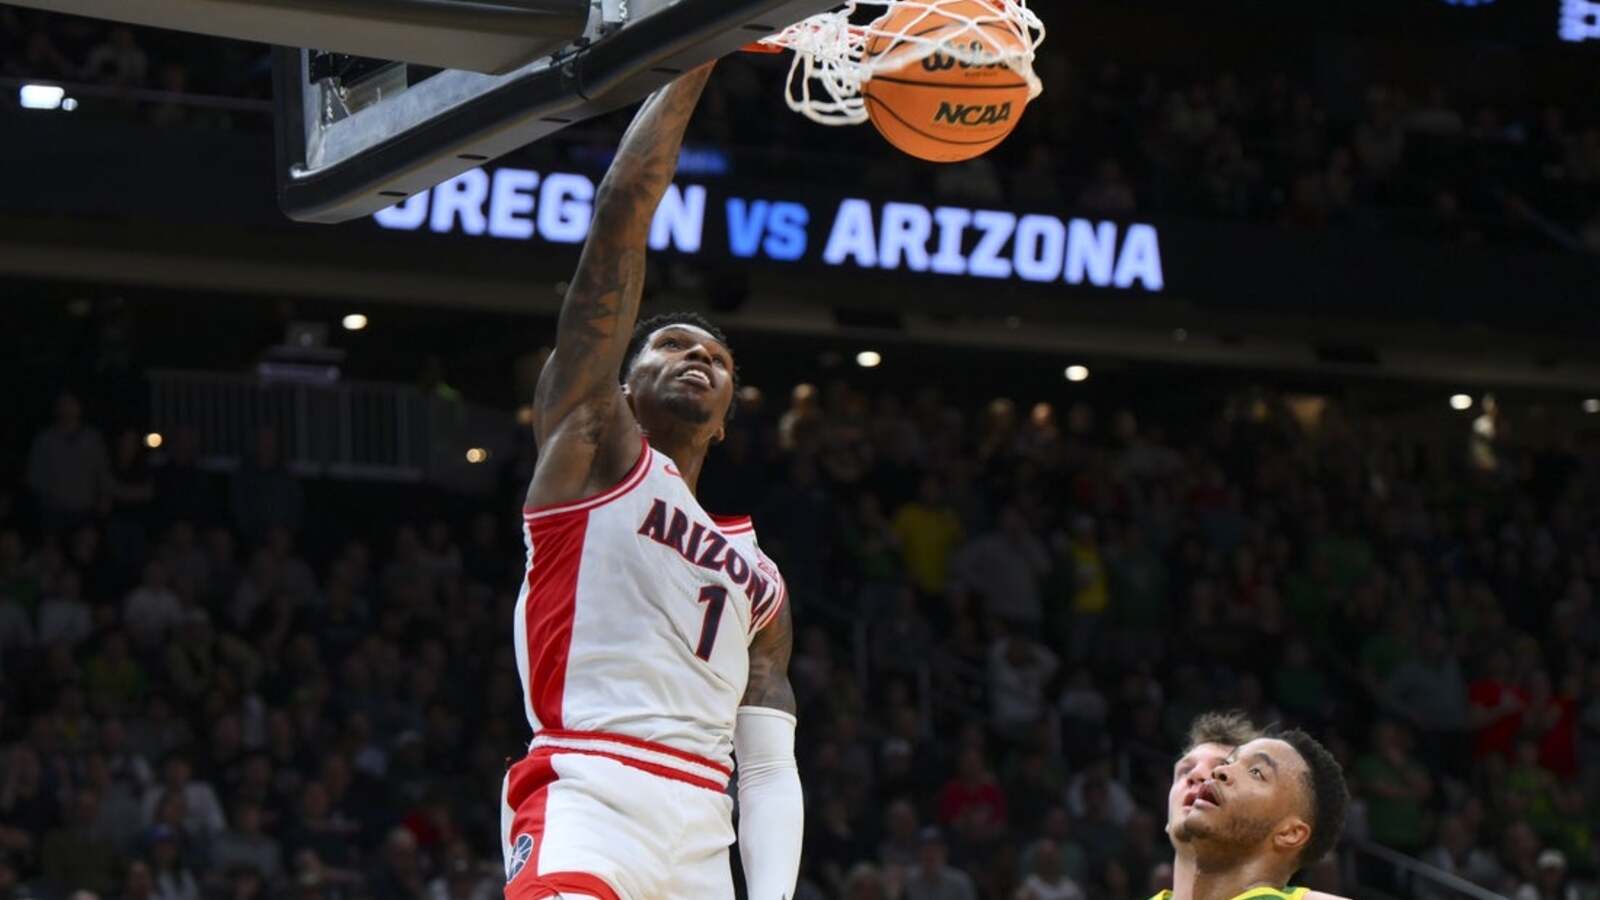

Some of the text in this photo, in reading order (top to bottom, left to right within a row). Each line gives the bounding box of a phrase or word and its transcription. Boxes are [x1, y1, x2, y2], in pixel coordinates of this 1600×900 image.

[934, 101, 1012, 126] NCAA
[373, 166, 1164, 291] REGN VS ARIZONA
[695, 585, 728, 662] 1
